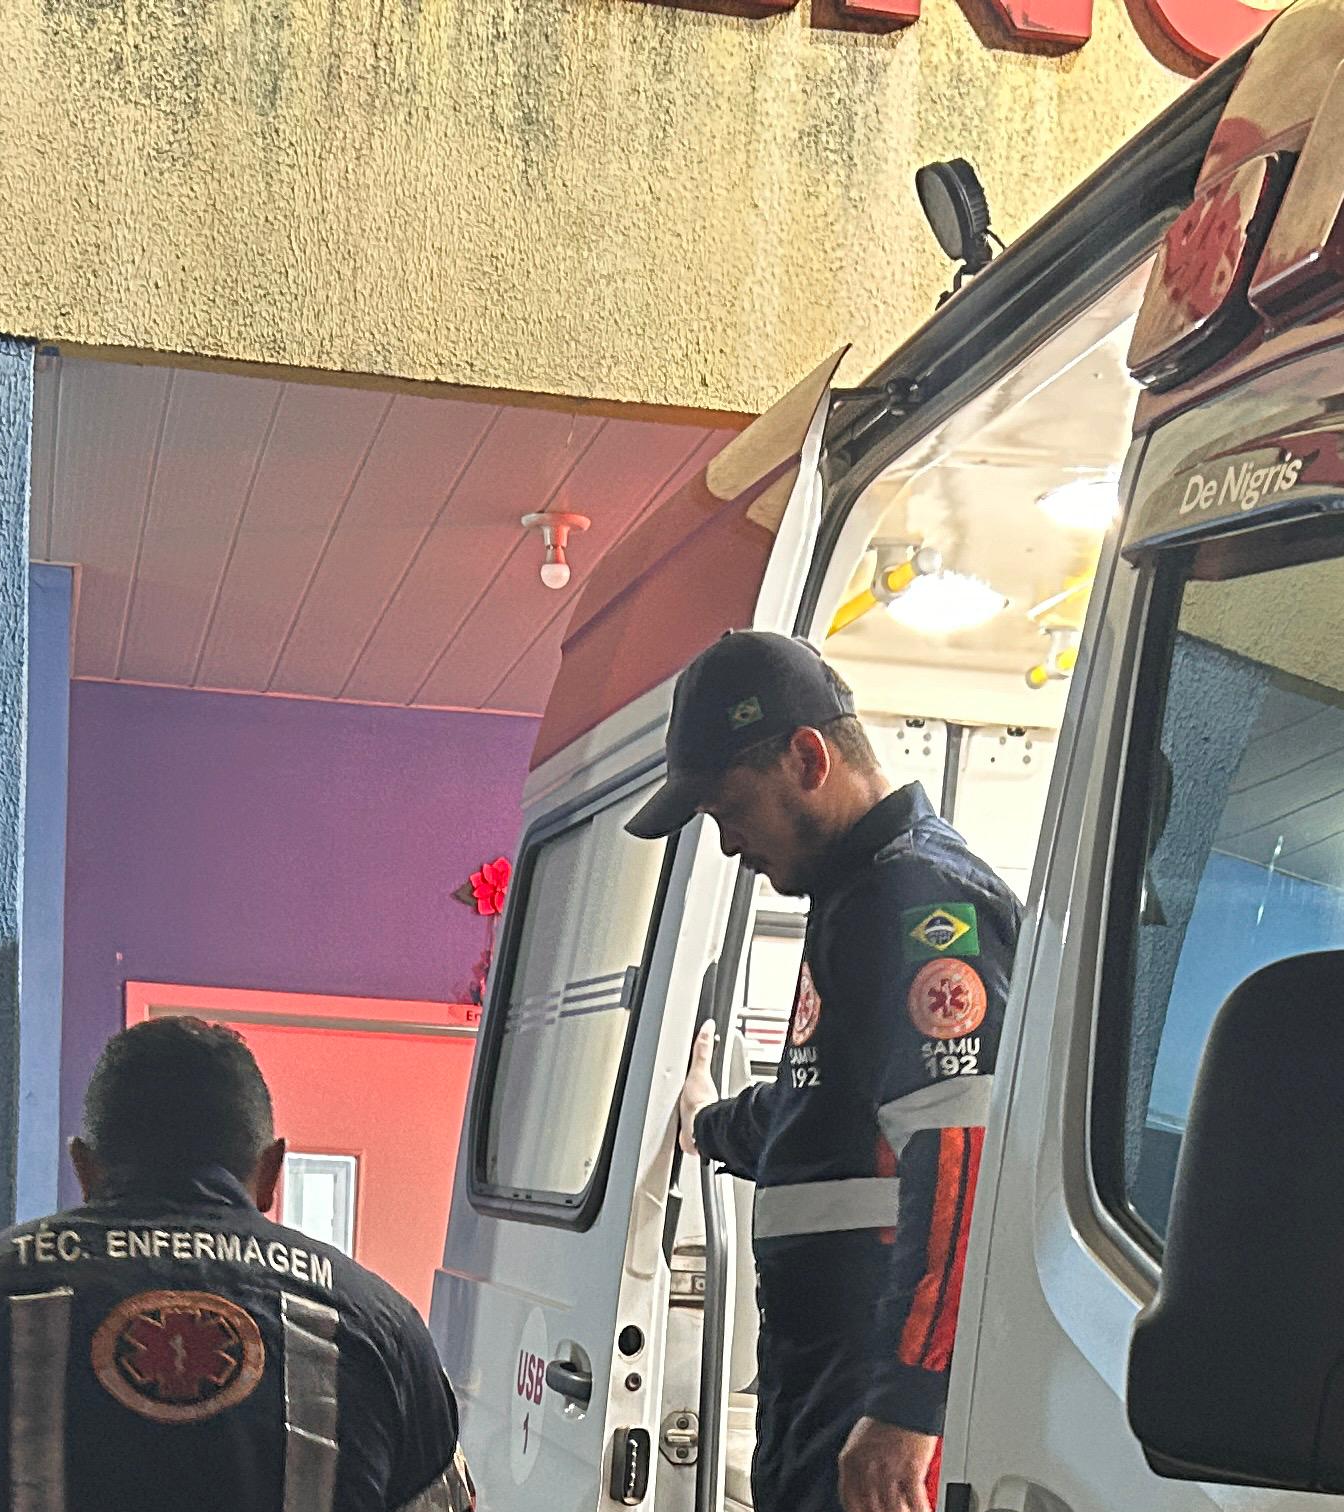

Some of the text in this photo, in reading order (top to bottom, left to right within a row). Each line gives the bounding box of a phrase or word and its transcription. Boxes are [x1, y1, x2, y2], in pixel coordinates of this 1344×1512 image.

[1179, 452, 1303, 515] De Nigris
[921, 1037, 981, 1058] SAMU
[925, 1055, 979, 1078] 192
[791, 1067, 821, 1088] 192
[11, 1222, 333, 1291] TÉC. ENFERMAGEM
[517, 1349, 545, 1405] USB
[522, 1411, 530, 1455] 1
